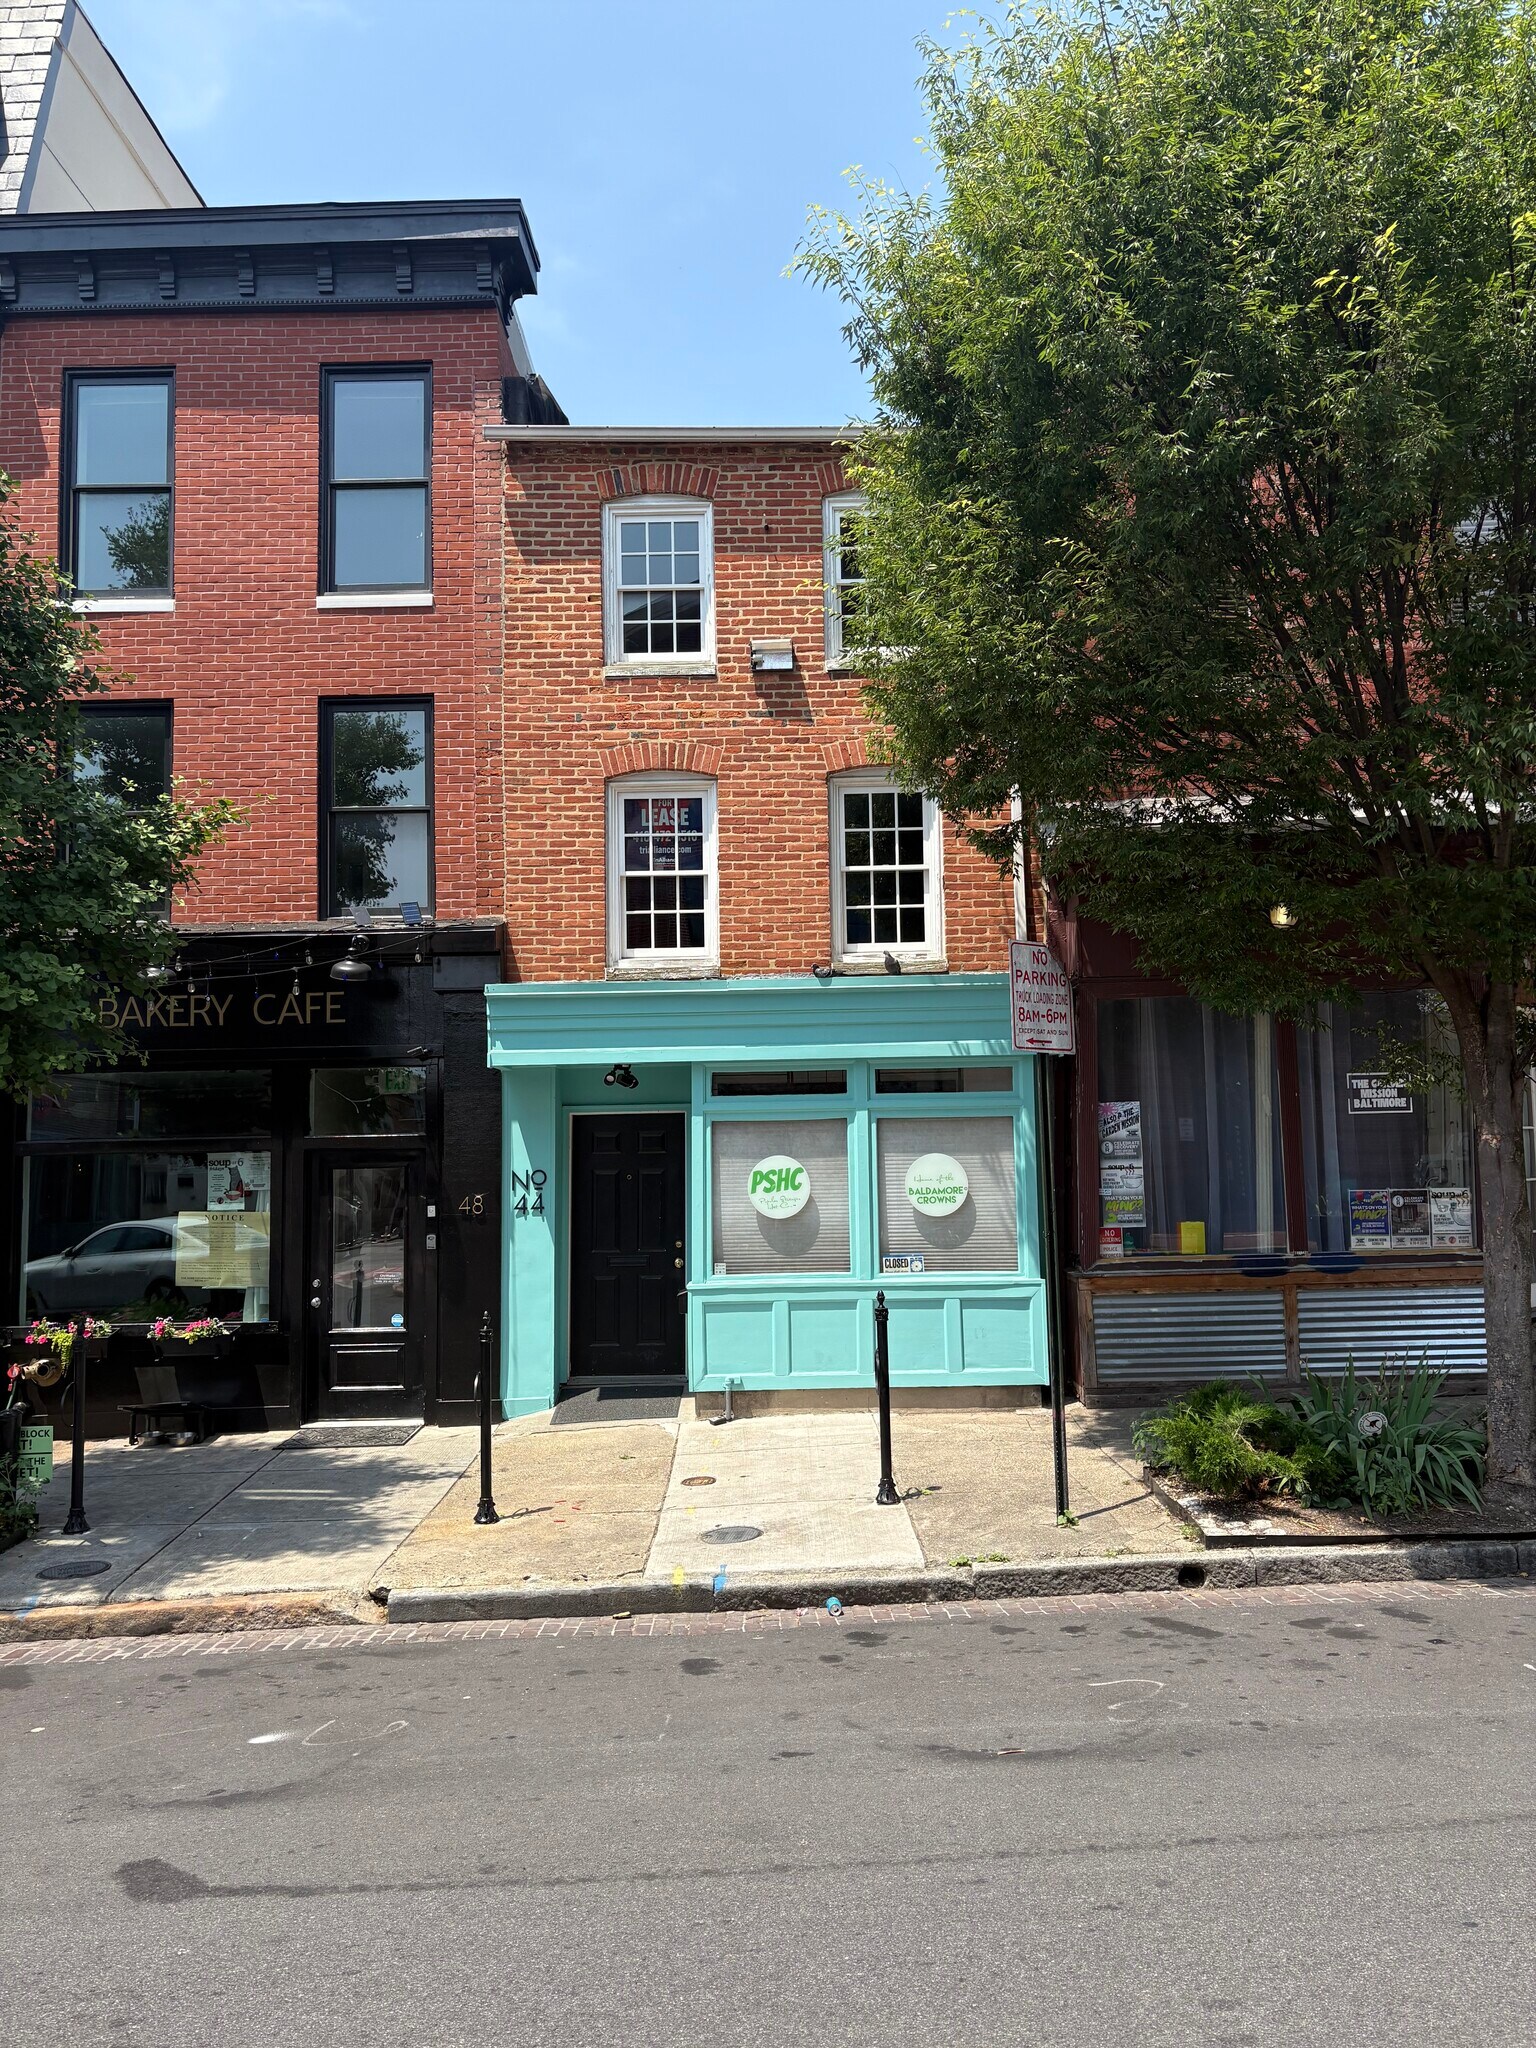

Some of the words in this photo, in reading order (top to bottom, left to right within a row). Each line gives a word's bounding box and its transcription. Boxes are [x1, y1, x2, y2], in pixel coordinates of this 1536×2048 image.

[658, 799, 672, 807] FOR
[641, 807, 689, 826] LEASE
[1032, 951, 1048, 966] NO
[1015, 970, 1067, 987] PARKING
[1015, 990, 1031, 1004] TRUCK
[1033, 991, 1054, 1005] LOADING
[1055, 993, 1068, 1006] ZONE
[98, 994, 234, 1030] BAKERY
[253, 991, 346, 1025] CAFE
[1018, 1007, 1067, 1024] 8AM-6PM
[1351, 1079, 1369, 1089] THE
[1360, 1088, 1398, 1098] MISSION
[1353, 1097, 1407, 1108] BALTIMORE
[208, 1159, 231, 1168] soup
[237, 1157, 244, 1167] 6
[751, 1166, 805, 1194] PSHC
[908, 1186, 964, 1196] BALDAMORE
[514, 1193, 545, 1215] 44
[916, 1195, 957, 1204] CROWNS
[458, 1196, 484, 1215] 48
[204, 1214, 245, 1222] NOTICE
[1104, 1229, 1115, 1237] NO
[884, 1258, 908, 1269] CLOSED
[20, 1429, 51, 1438] BLOCK
[29, 1457, 46, 1465] THE
